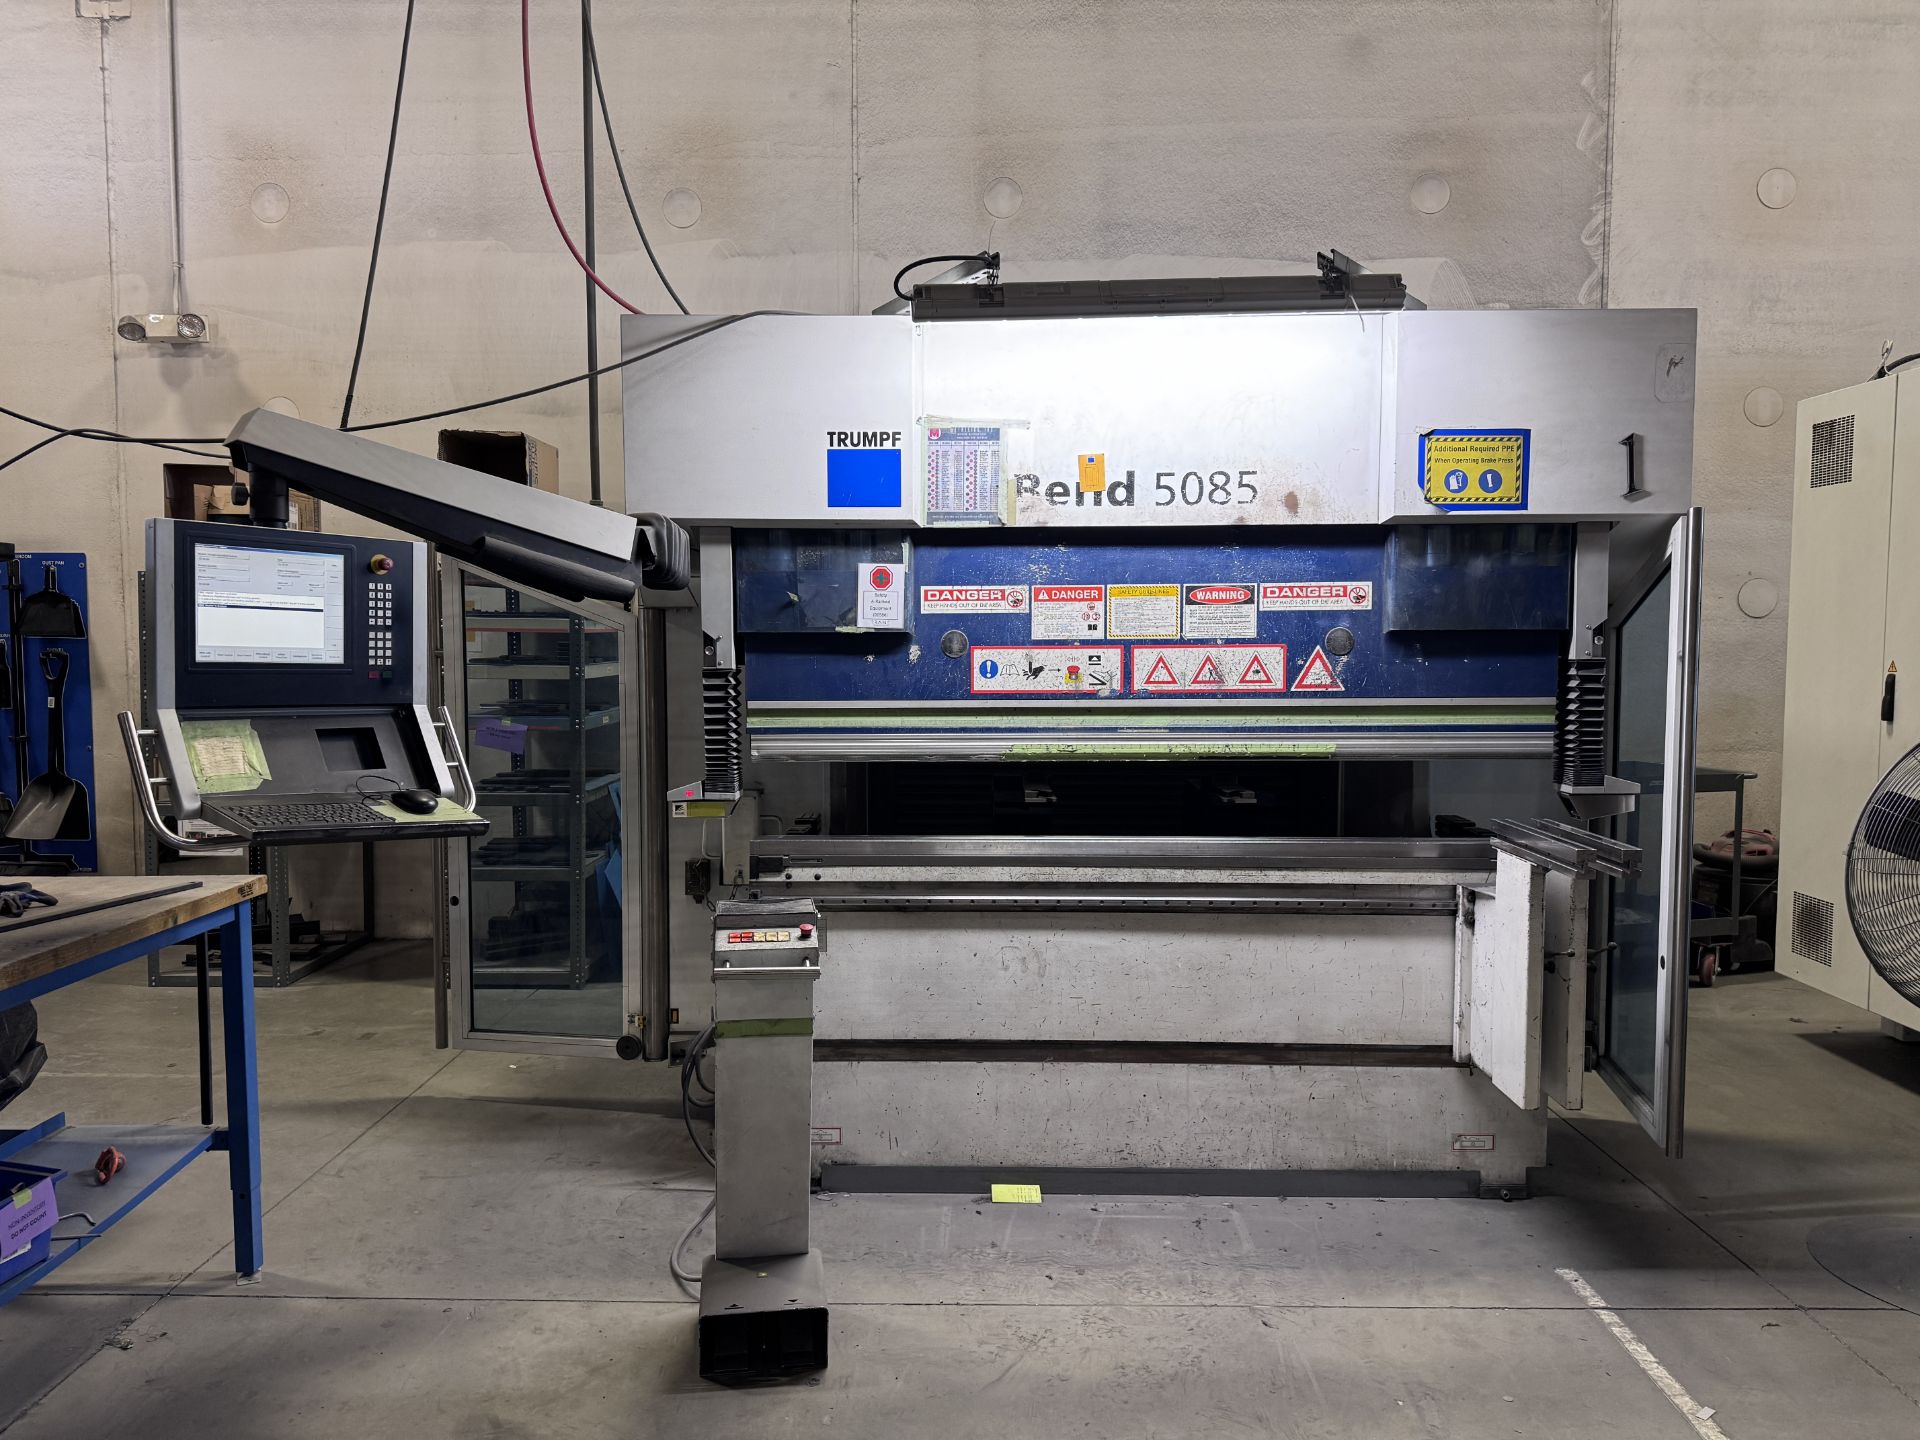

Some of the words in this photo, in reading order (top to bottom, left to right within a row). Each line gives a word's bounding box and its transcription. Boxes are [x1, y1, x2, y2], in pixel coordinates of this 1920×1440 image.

[826, 431, 902, 448] TRUMPF
[1469, 445, 1500, 453] Required
[1155, 470, 1258, 506] 5085
[927, 590, 1002, 600] DANGER
[1051, 590, 1099, 599] DANGER
[1196, 591, 1245, 600] WARNING
[1266, 587, 1344, 597] DANGER
[30, 1210, 47, 1225] COUNT
